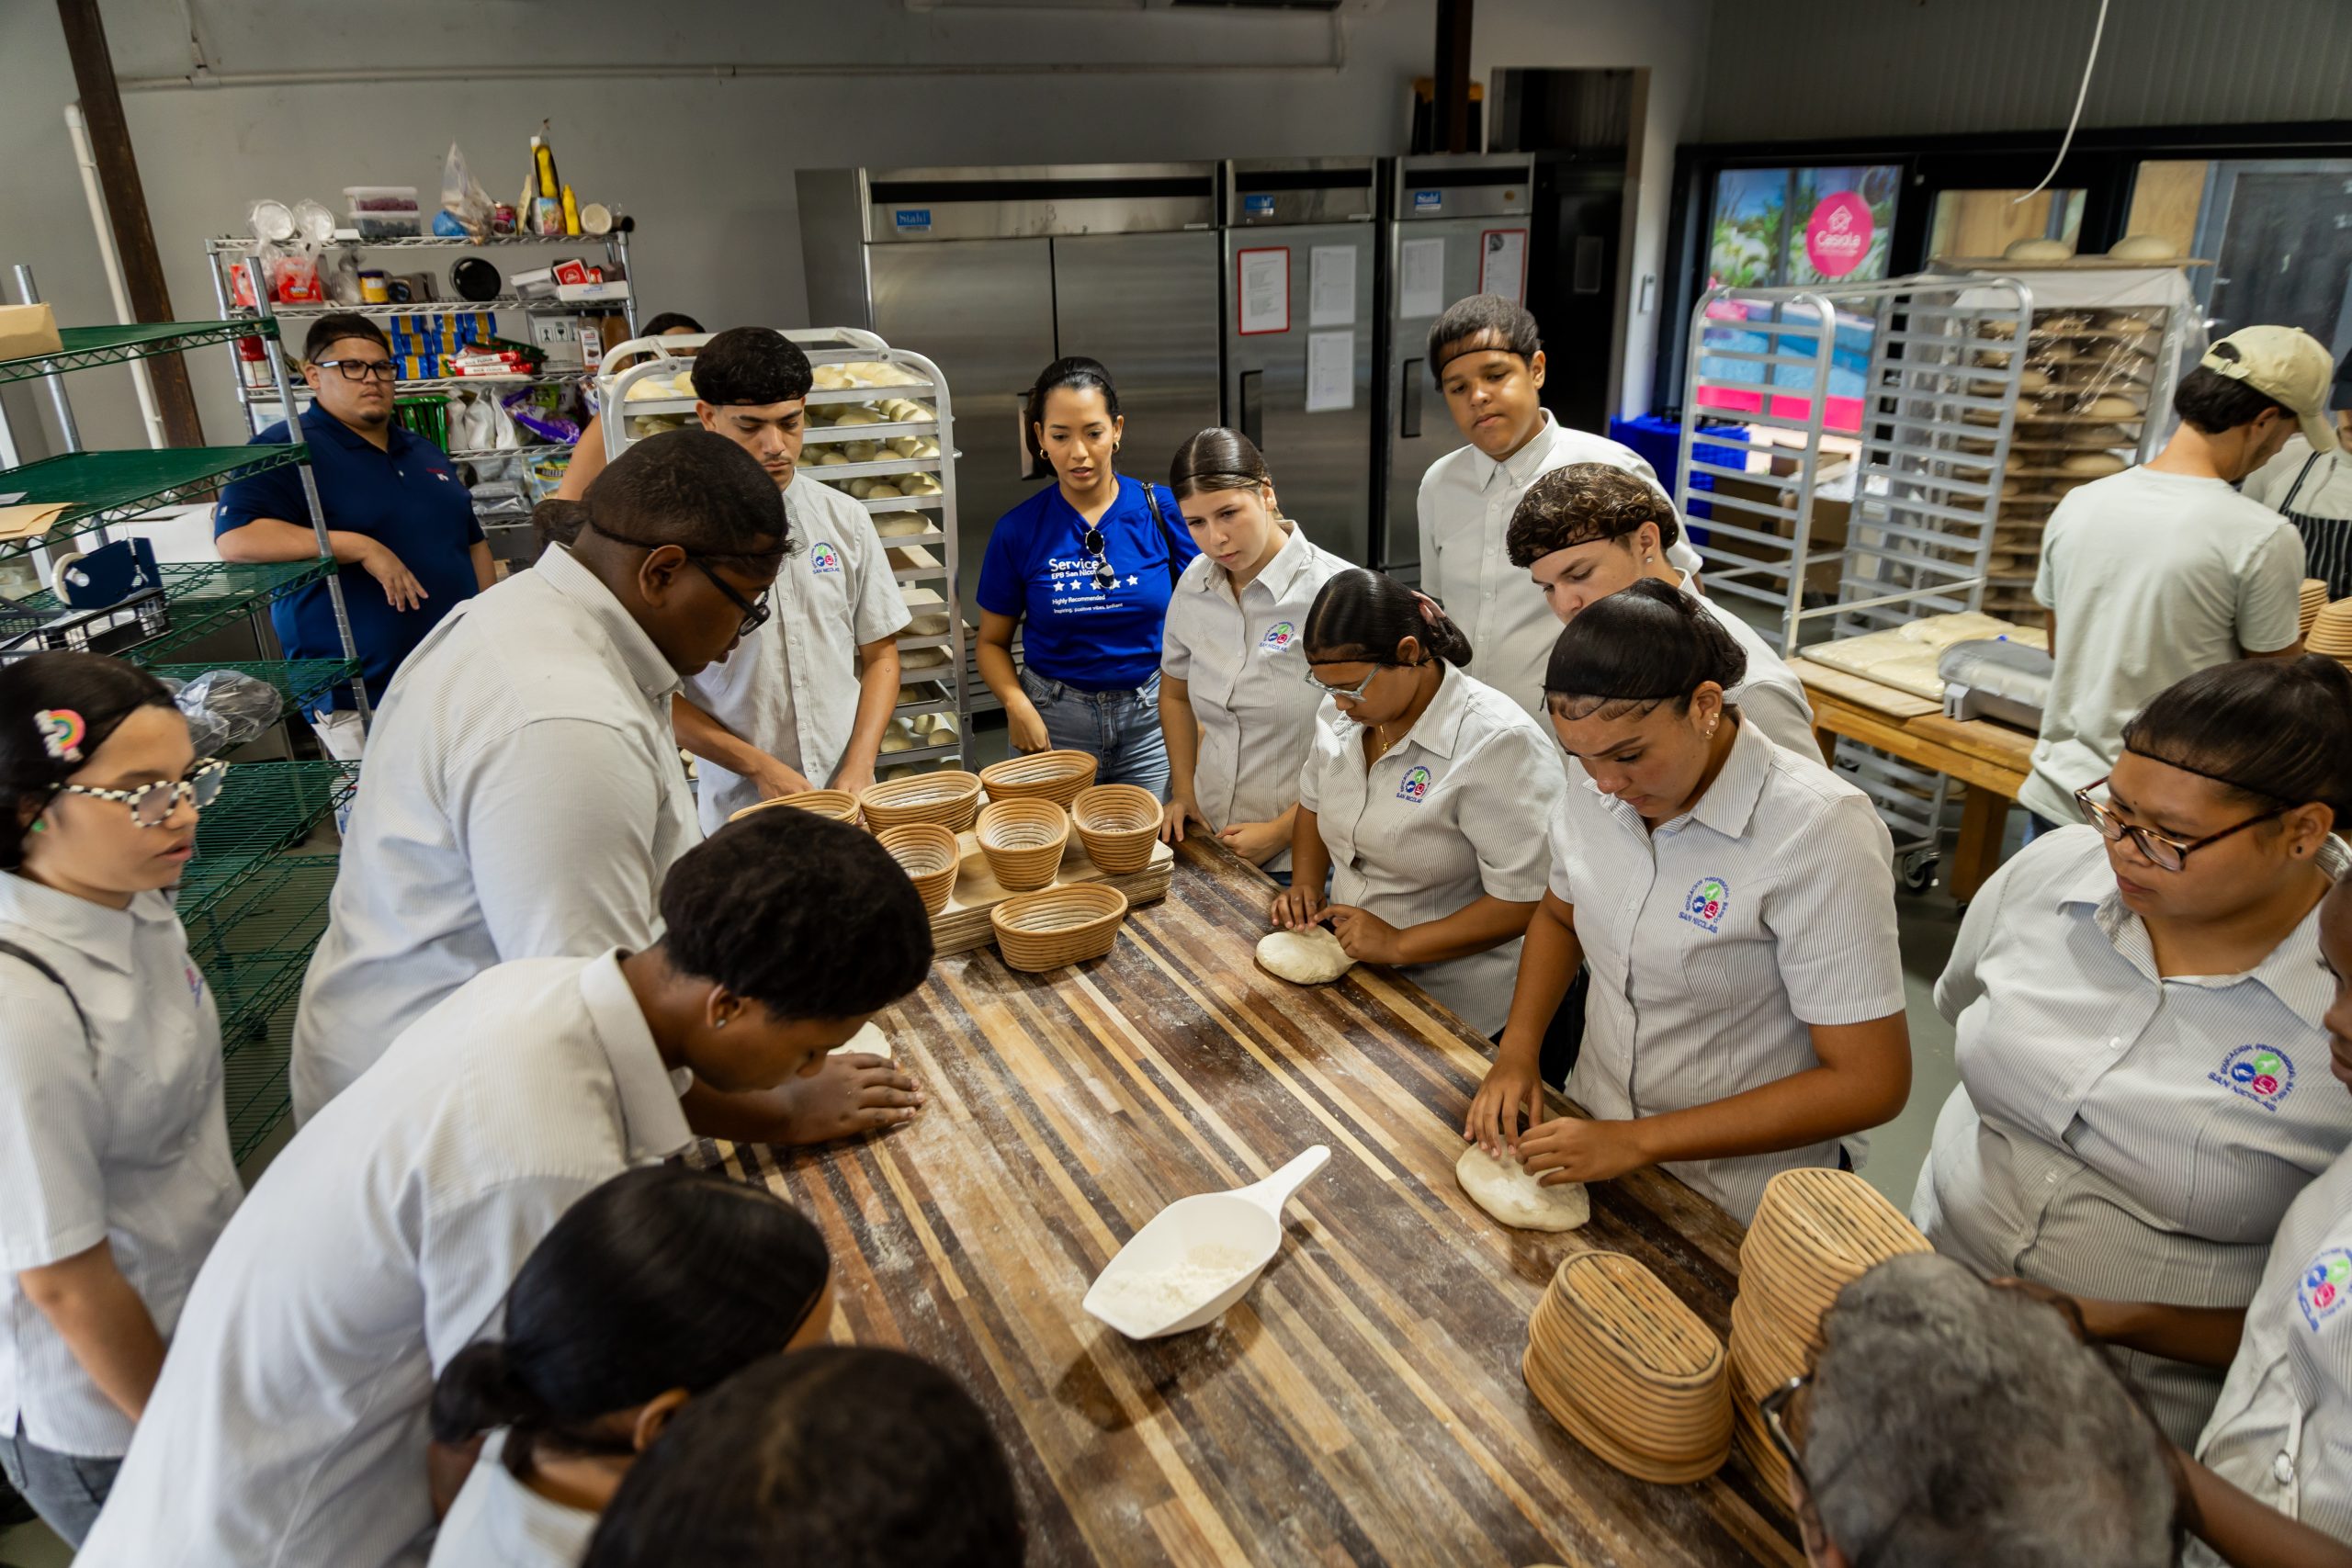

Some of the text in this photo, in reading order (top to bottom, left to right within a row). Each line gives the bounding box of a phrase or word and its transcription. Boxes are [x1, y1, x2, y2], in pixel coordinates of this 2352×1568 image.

[1048, 558, 1099, 572] Service
[1051, 571, 1065, 580] EPB
[1052, 593, 1106, 606] Highly Recommended
[1678, 911, 1718, 933] SAN NICOLAS
[2207, 1071, 2278, 1111] SAN NICOLAS
